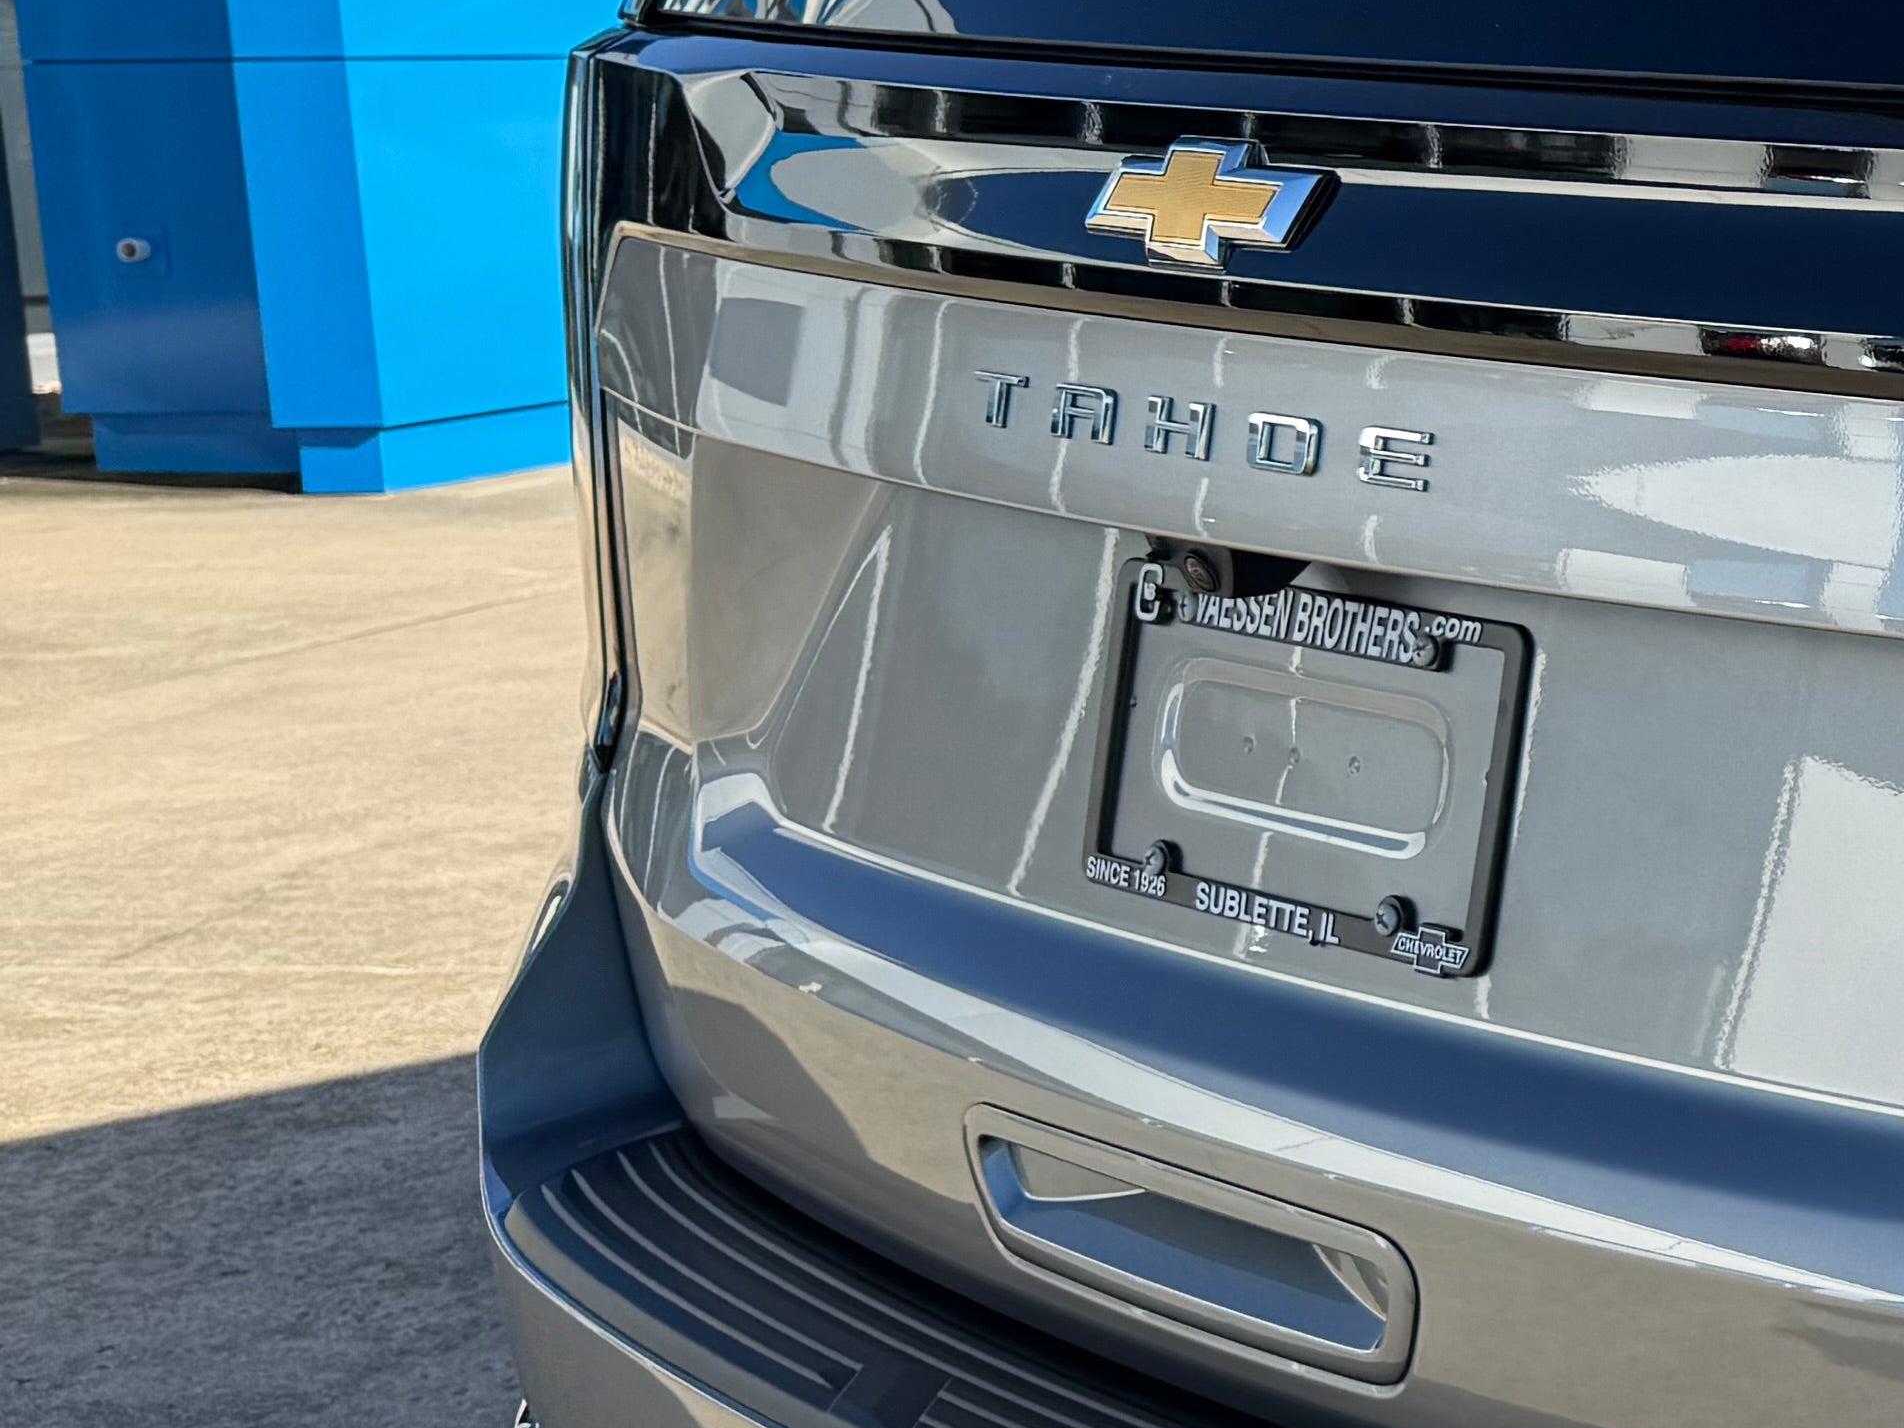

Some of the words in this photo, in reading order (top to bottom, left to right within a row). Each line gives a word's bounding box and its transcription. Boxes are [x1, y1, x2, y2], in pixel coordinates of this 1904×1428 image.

[974, 369, 1435, 493] TAHOE
[1196, 589, 1295, 640] VAESSEN
[1086, 855, 1131, 888] SINCE
[1133, 869, 1168, 898] 1926
[1194, 881, 1314, 943] SUBLETTE,
[1319, 911, 1341, 945] IL
[1397, 937, 1463, 965] CHEVROLET
